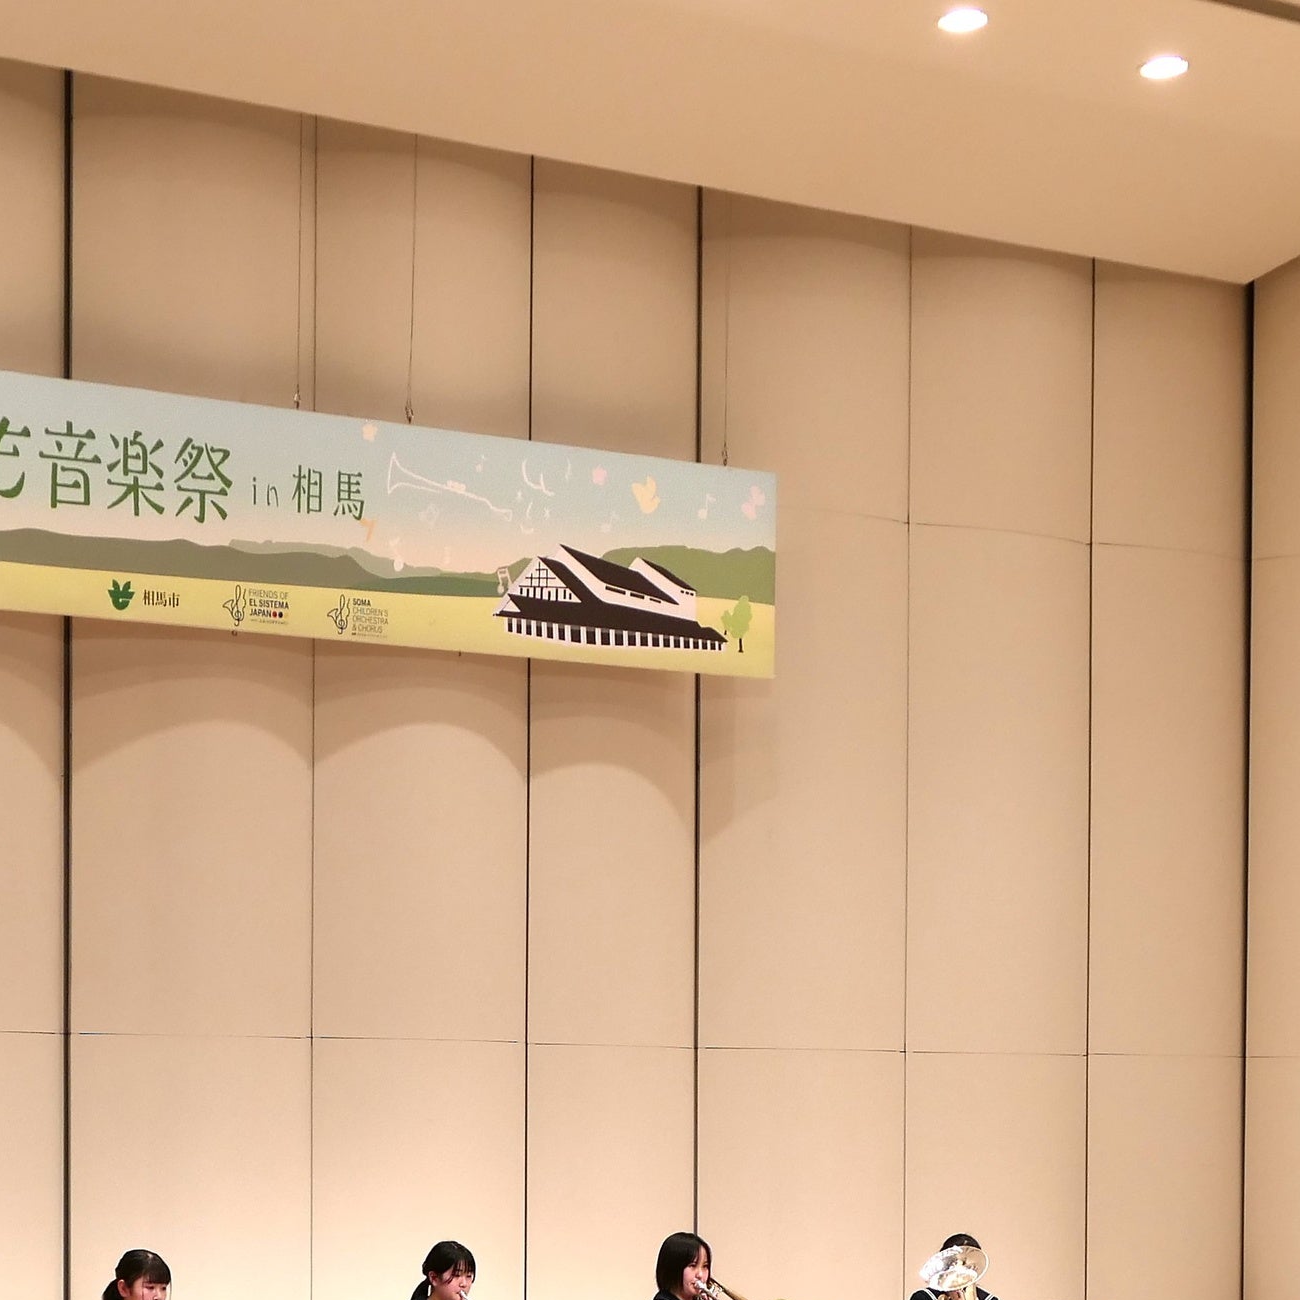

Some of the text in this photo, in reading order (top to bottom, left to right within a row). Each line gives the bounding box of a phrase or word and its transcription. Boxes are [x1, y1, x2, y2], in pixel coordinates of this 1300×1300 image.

[252, 475, 279, 508] in
[291, 464, 366, 521] 相馬
[143, 589, 180, 608] 相馬市
[249, 588, 289, 600] FRIENDS OF
[249, 598, 290, 610] EL SISTEMA
[353, 598, 371, 607] SOMA
[250, 608, 272, 618] JAPAN
[352, 615, 389, 626] ORCHESTRA
[358, 624, 383, 634] CHORUS
